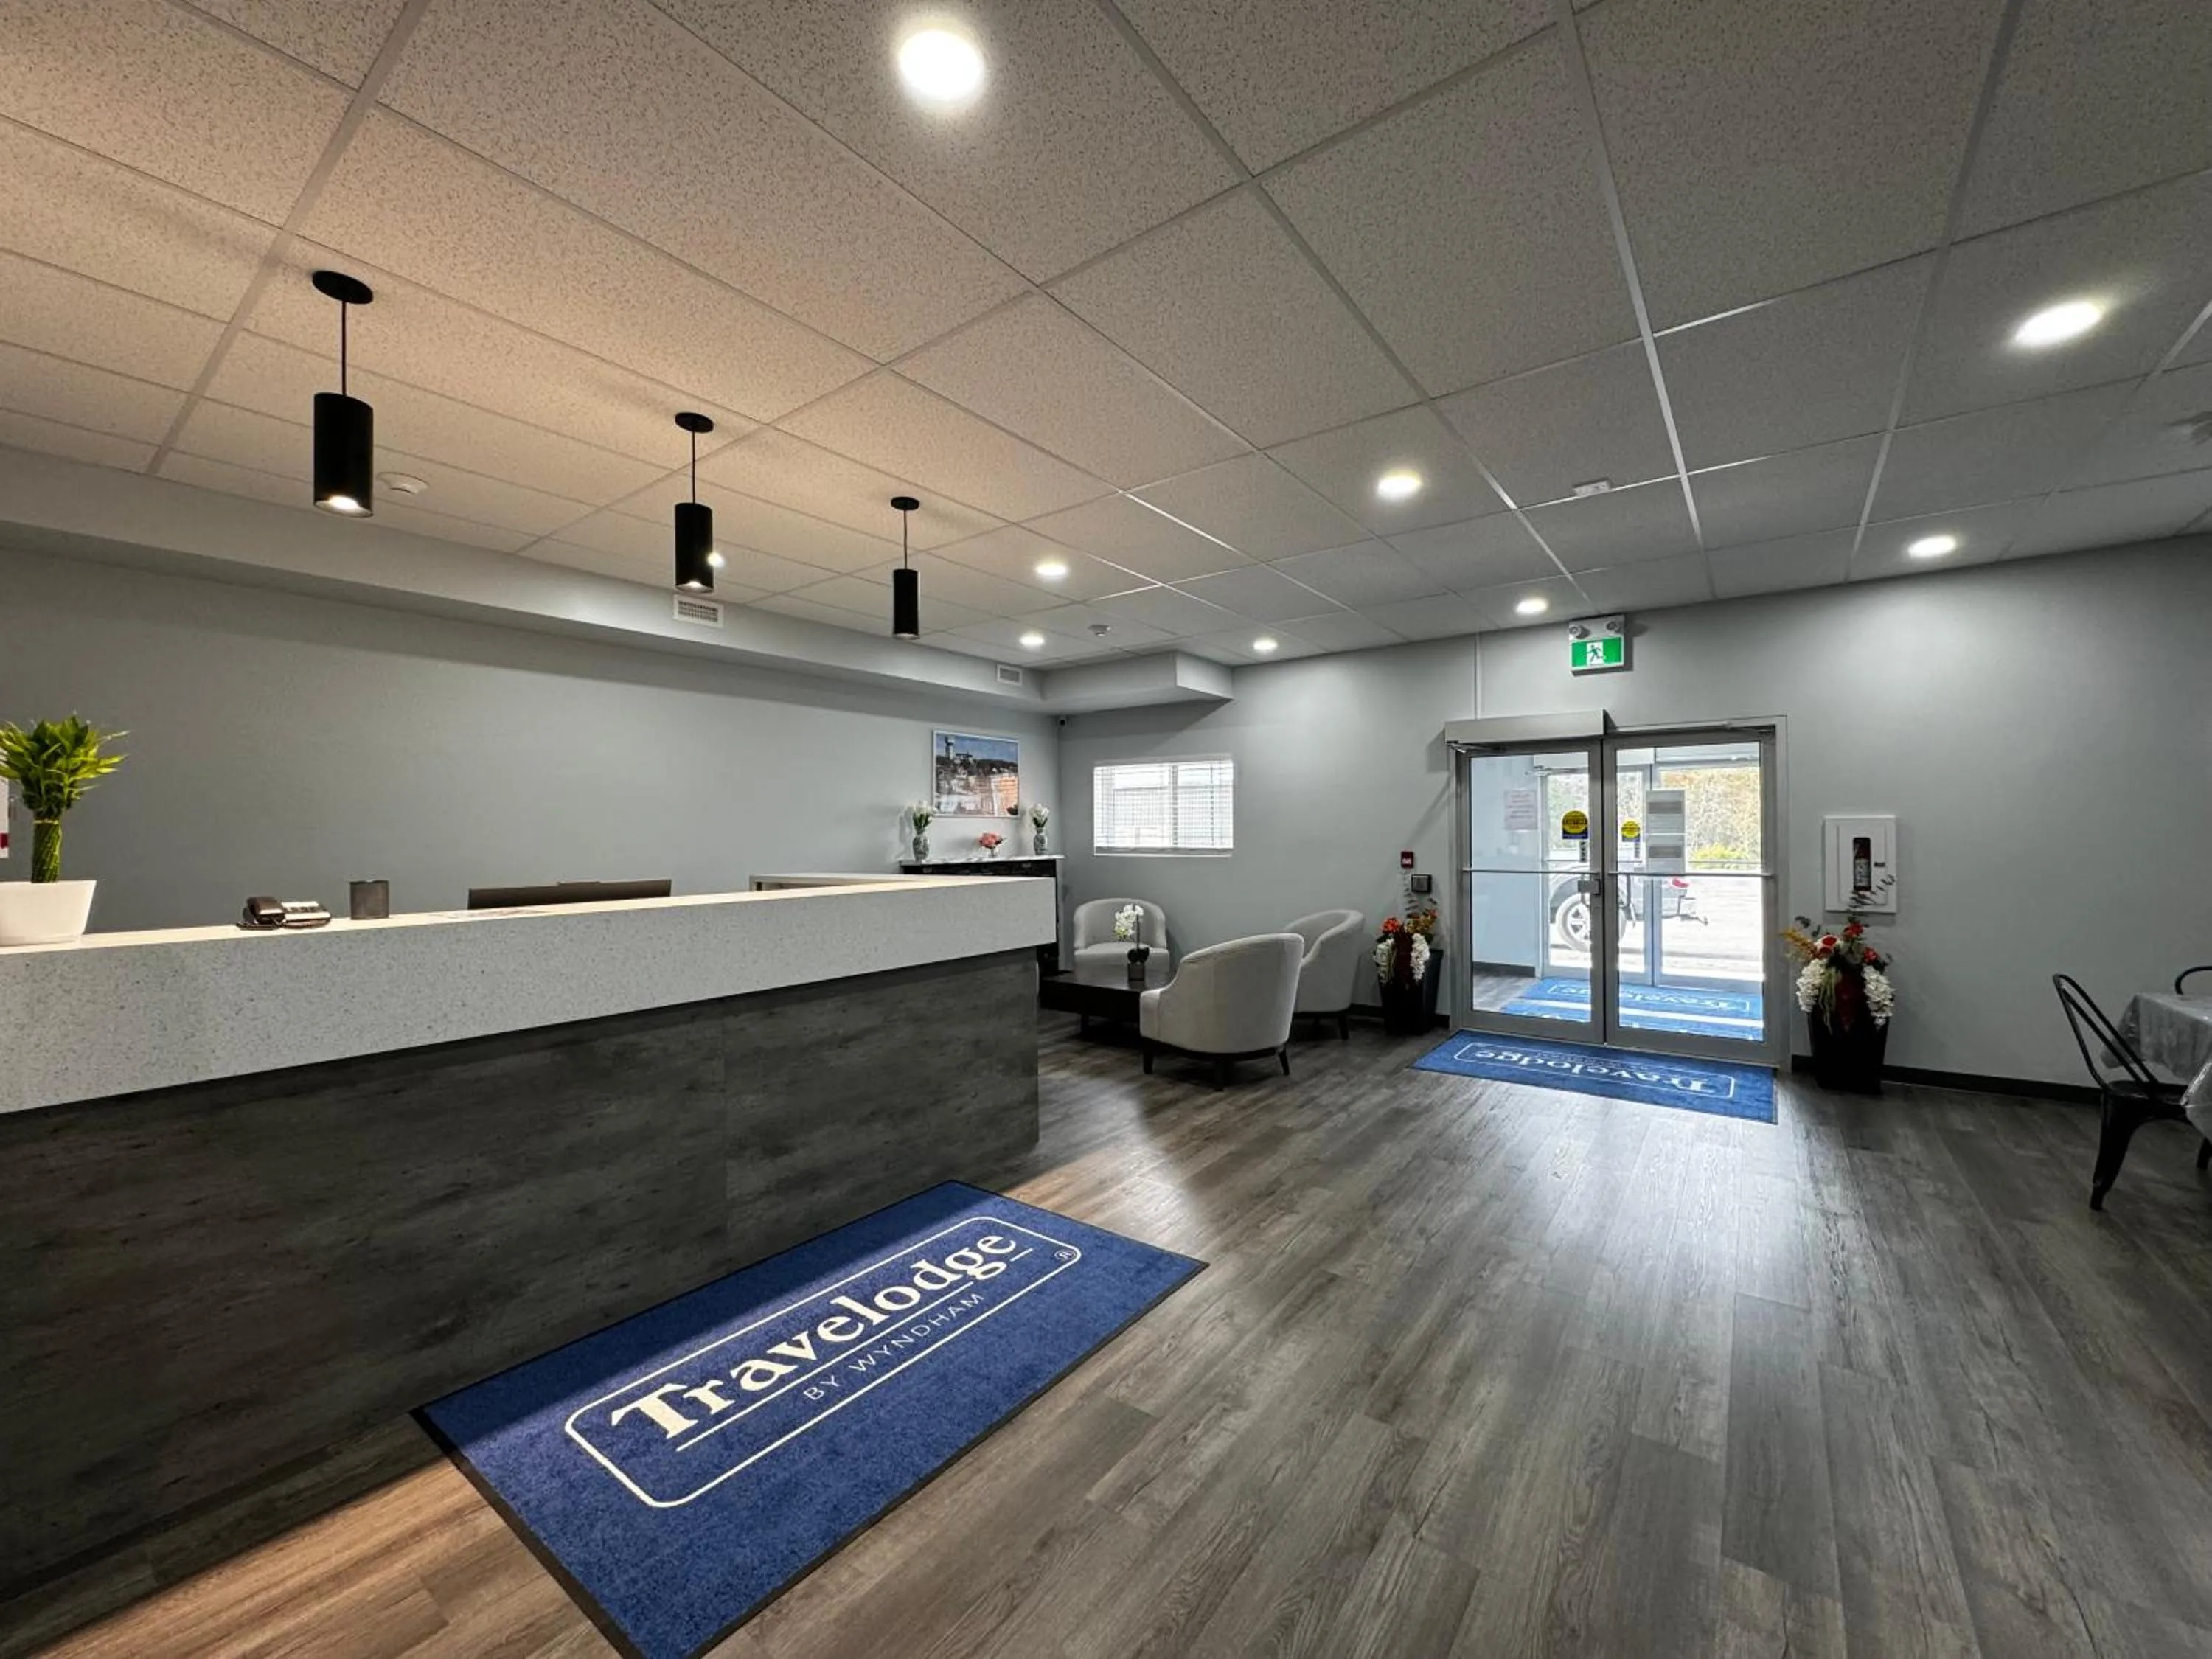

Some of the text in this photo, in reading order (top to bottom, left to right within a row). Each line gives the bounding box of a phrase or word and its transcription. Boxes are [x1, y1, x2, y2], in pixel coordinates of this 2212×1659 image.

[1475, 1049, 1716, 1093] Travelodge
[611, 1235, 1016, 1439] Travelodge
[803, 1293, 984, 1400] BY WYNDHAM
